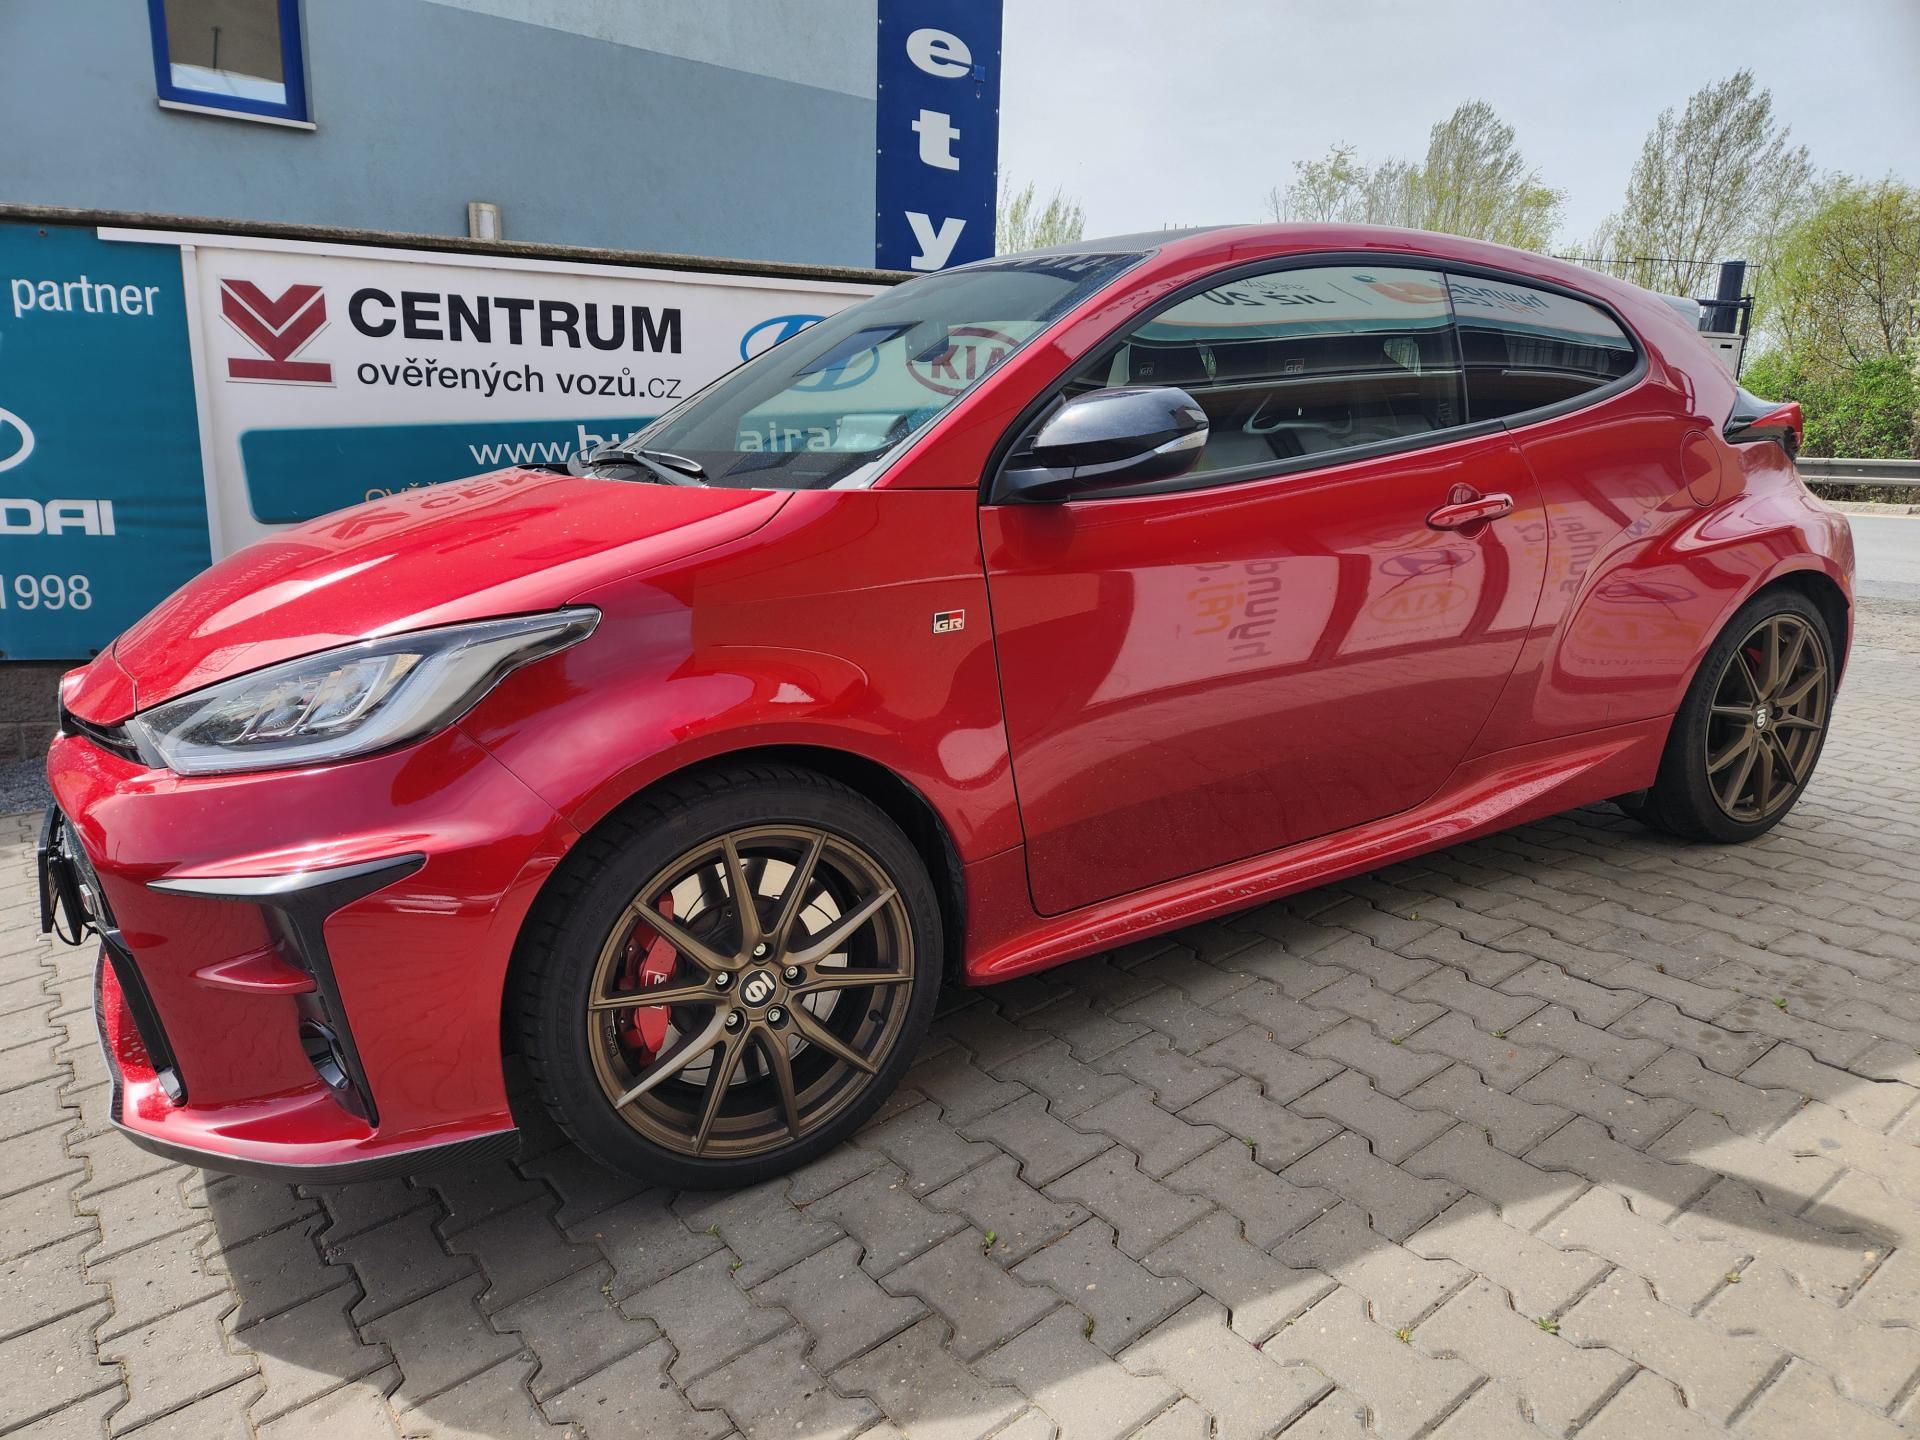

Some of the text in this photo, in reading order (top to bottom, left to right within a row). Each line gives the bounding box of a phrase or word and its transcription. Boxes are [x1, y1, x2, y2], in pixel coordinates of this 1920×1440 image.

[12, 275, 160, 318] partner
[348, 287, 683, 354] CENTRUM
[357, 357, 683, 399] ověřených vozů.cz
[935, 617, 963, 631] GR
